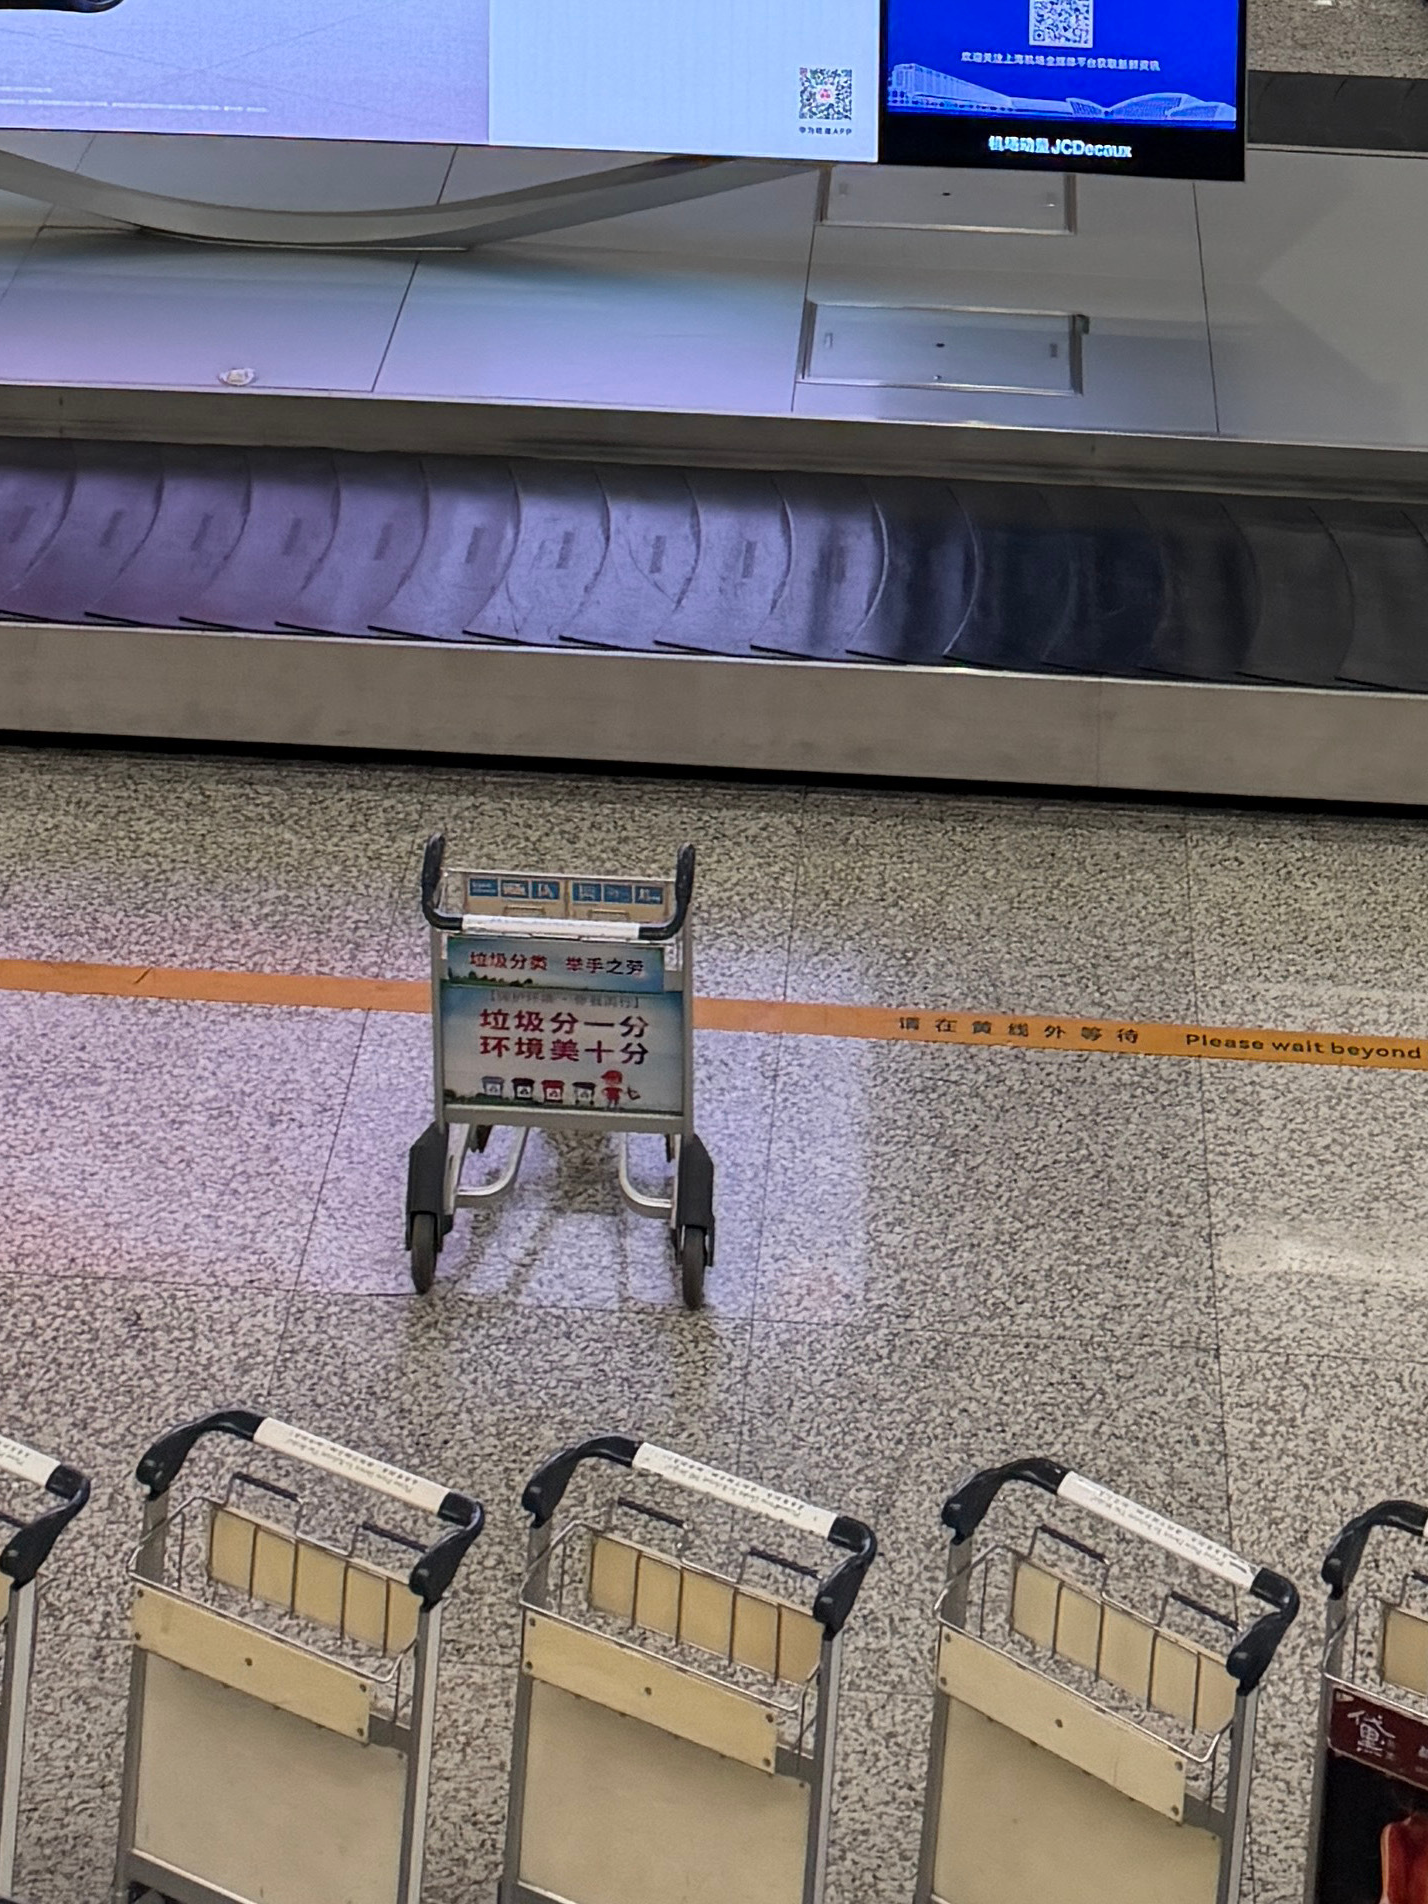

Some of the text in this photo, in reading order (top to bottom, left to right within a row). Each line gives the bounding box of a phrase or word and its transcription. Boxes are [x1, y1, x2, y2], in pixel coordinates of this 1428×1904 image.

[470, 951, 548, 971] 垃圾分类
[480, 1008, 649, 1038] 垃圾分一分
[900, 1016, 1139, 1043] 请在黄线外等待
[1185, 1033, 1263, 1050] Please
[1272, 1040, 1322, 1054] wait
[1331, 1042, 1421, 1060] beyond
[480, 1035, 649, 1065] 环境美十分
